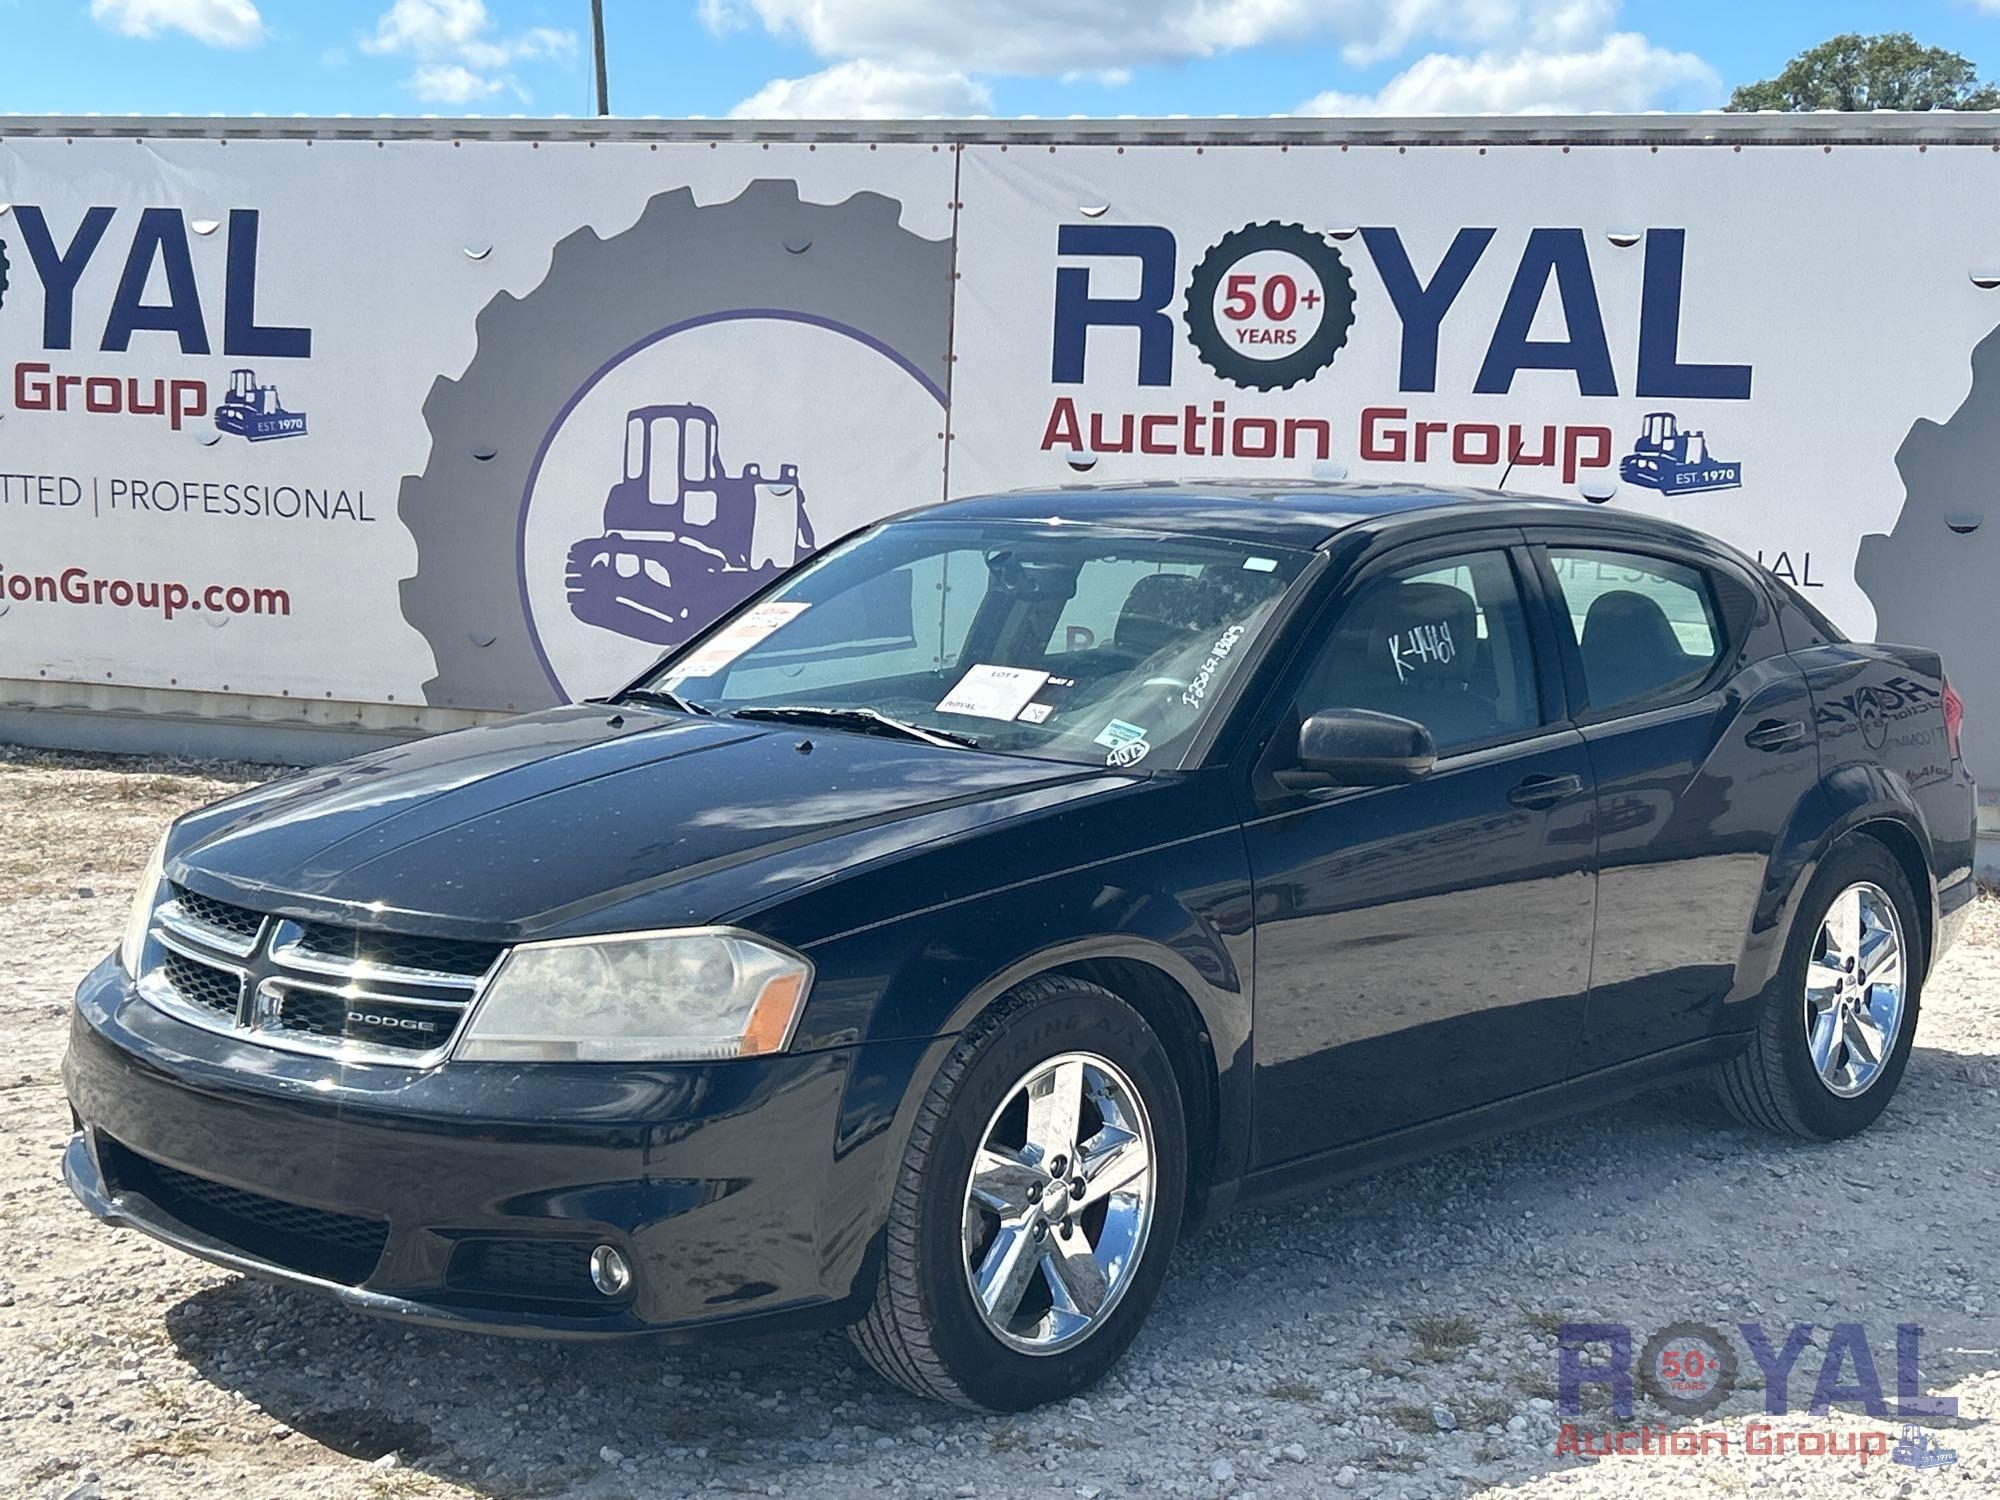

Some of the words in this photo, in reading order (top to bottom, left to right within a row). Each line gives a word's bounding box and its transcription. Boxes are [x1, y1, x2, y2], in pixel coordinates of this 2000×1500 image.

[0, 205, 311, 358] YAL
[1223, 274, 1321, 321] 50+
[1236, 328, 1296, 345] YEARS
[15, 362, 207, 430] Group
[279, 419, 303, 430] 1970
[1041, 397, 1330, 459] Auction
[1360, 407, 1612, 484] Group
[1702, 469, 1734, 481] 1970
[111, 479, 375, 522] PROFESSIONAL
[347, 1012, 434, 1031] DODGE
